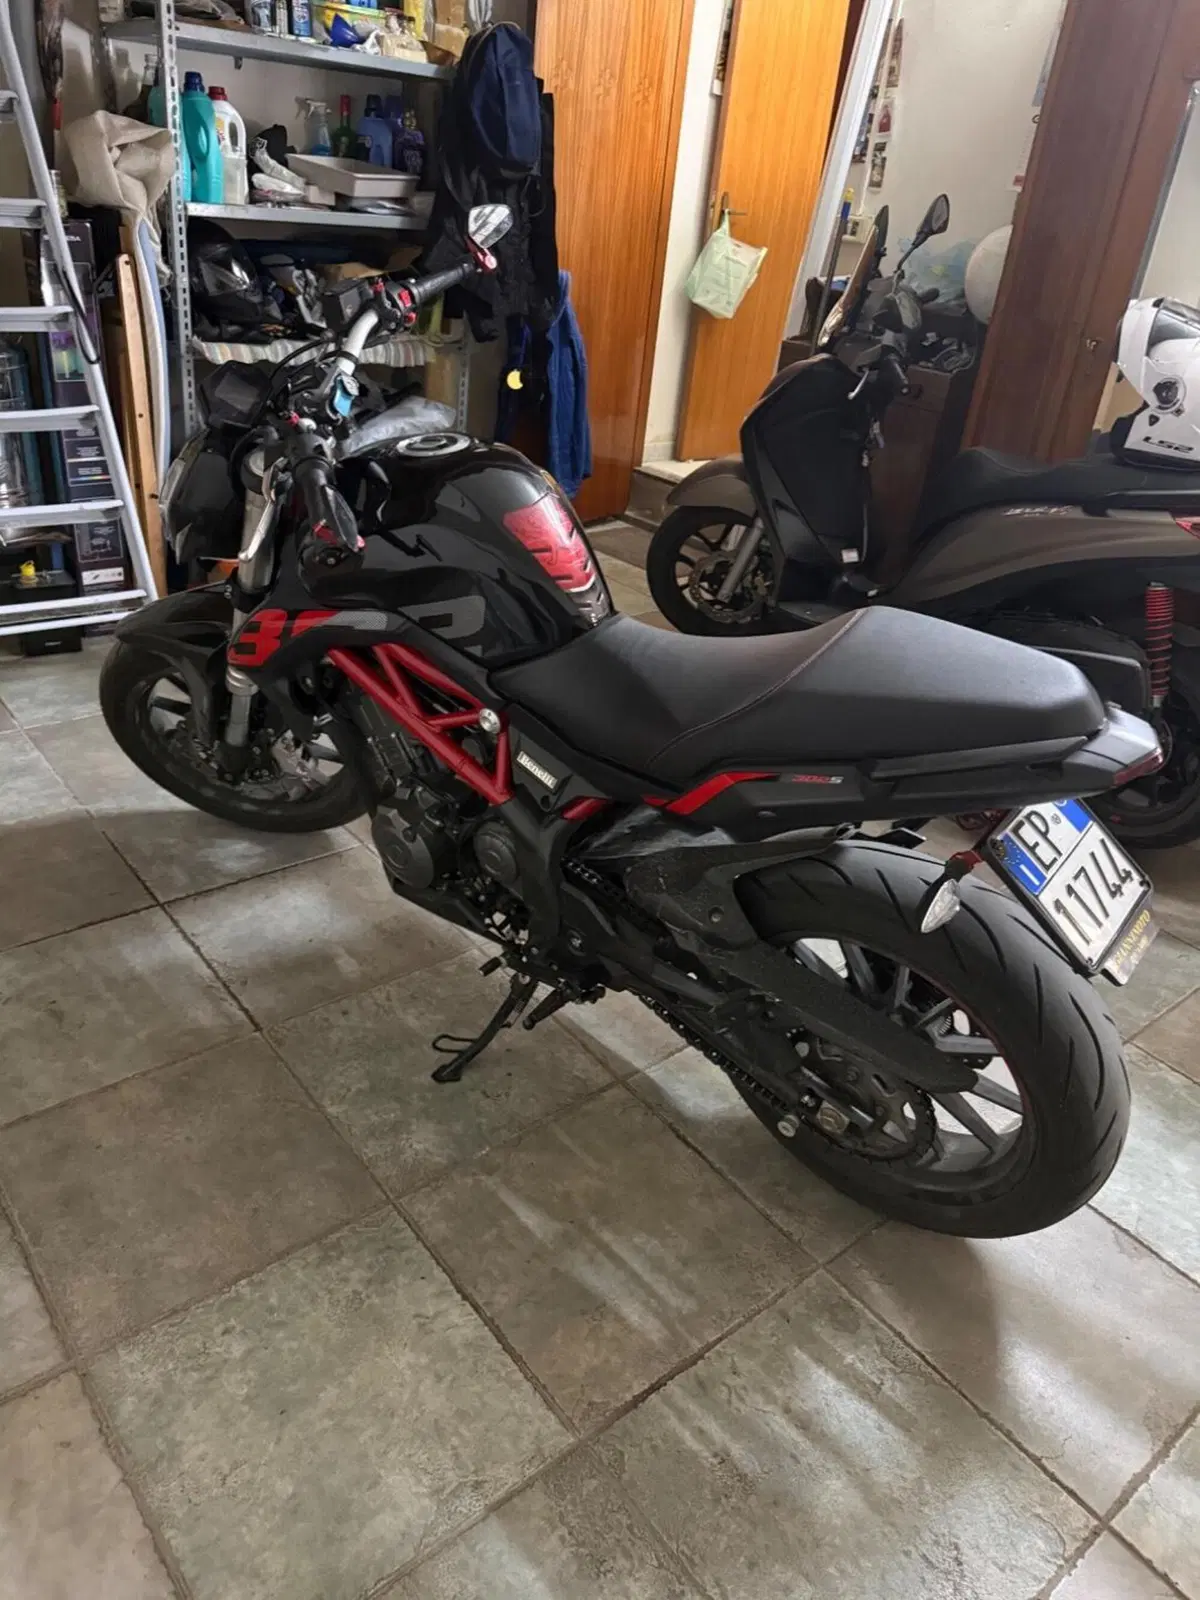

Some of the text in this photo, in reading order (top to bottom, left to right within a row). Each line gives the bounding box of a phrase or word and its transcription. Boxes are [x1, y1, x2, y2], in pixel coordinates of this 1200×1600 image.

[1142, 436, 1194, 454] LS2
[519, 752, 557, 788] Benelli
[1010, 810, 1063, 876] EP
[1052, 838, 1134, 946] 11744
